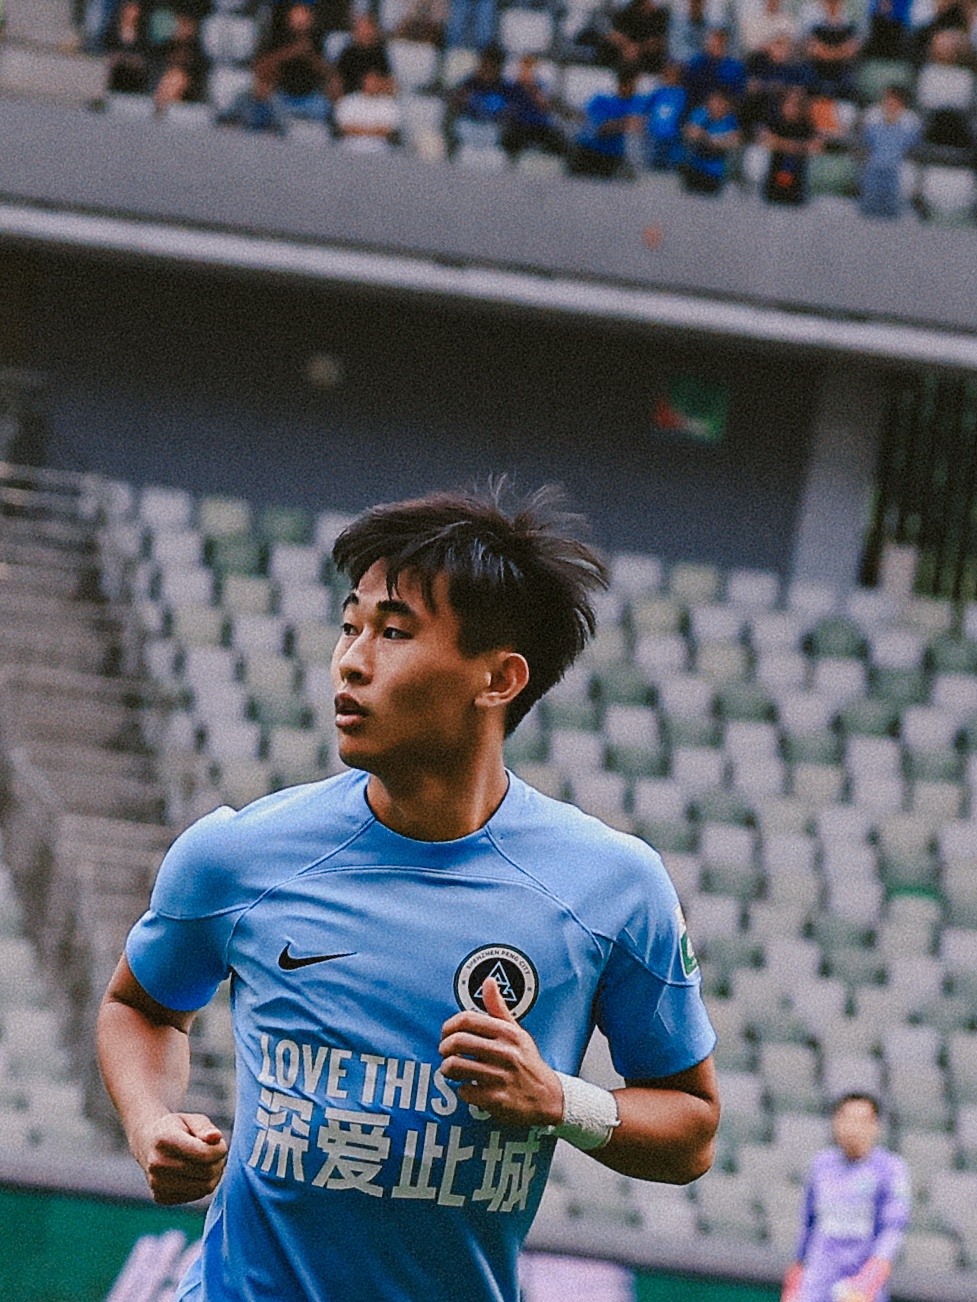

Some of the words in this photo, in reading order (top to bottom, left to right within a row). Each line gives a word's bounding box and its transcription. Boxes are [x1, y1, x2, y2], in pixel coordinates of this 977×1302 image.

[466, 949, 500, 970] SHENZHEN
[501, 950, 519, 962] PENG
[519, 960, 531, 975] CITY
[257, 1034, 353, 1099] LOVE
[360, 1053, 458, 1116] THIS
[247, 1087, 541, 1213] 深爱此城
